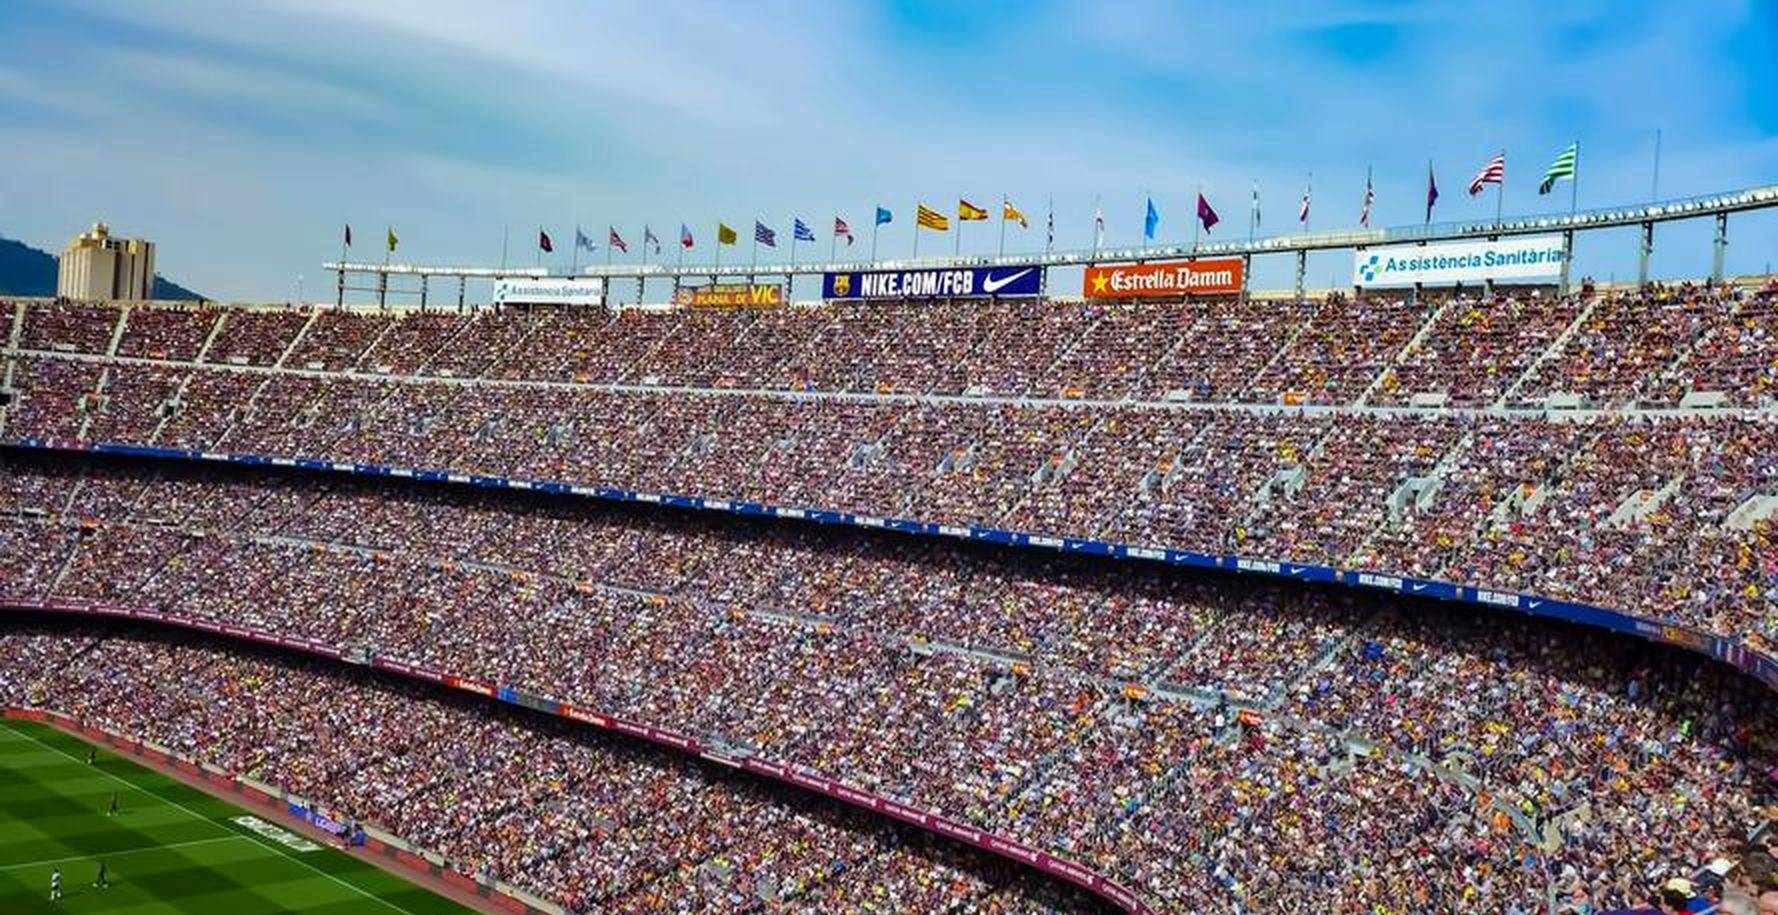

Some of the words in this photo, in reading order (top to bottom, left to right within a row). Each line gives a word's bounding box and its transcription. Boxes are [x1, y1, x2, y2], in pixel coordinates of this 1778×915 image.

[1385, 253, 1481, 273] Assistència
[1484, 248, 1564, 267] Sanitària
[860, 271, 974, 296] NIKE.COM/FCB
[1110, 268, 1174, 292] Estrella
[1177, 267, 1233, 289] Damm
[750, 284, 779, 304] VIC
